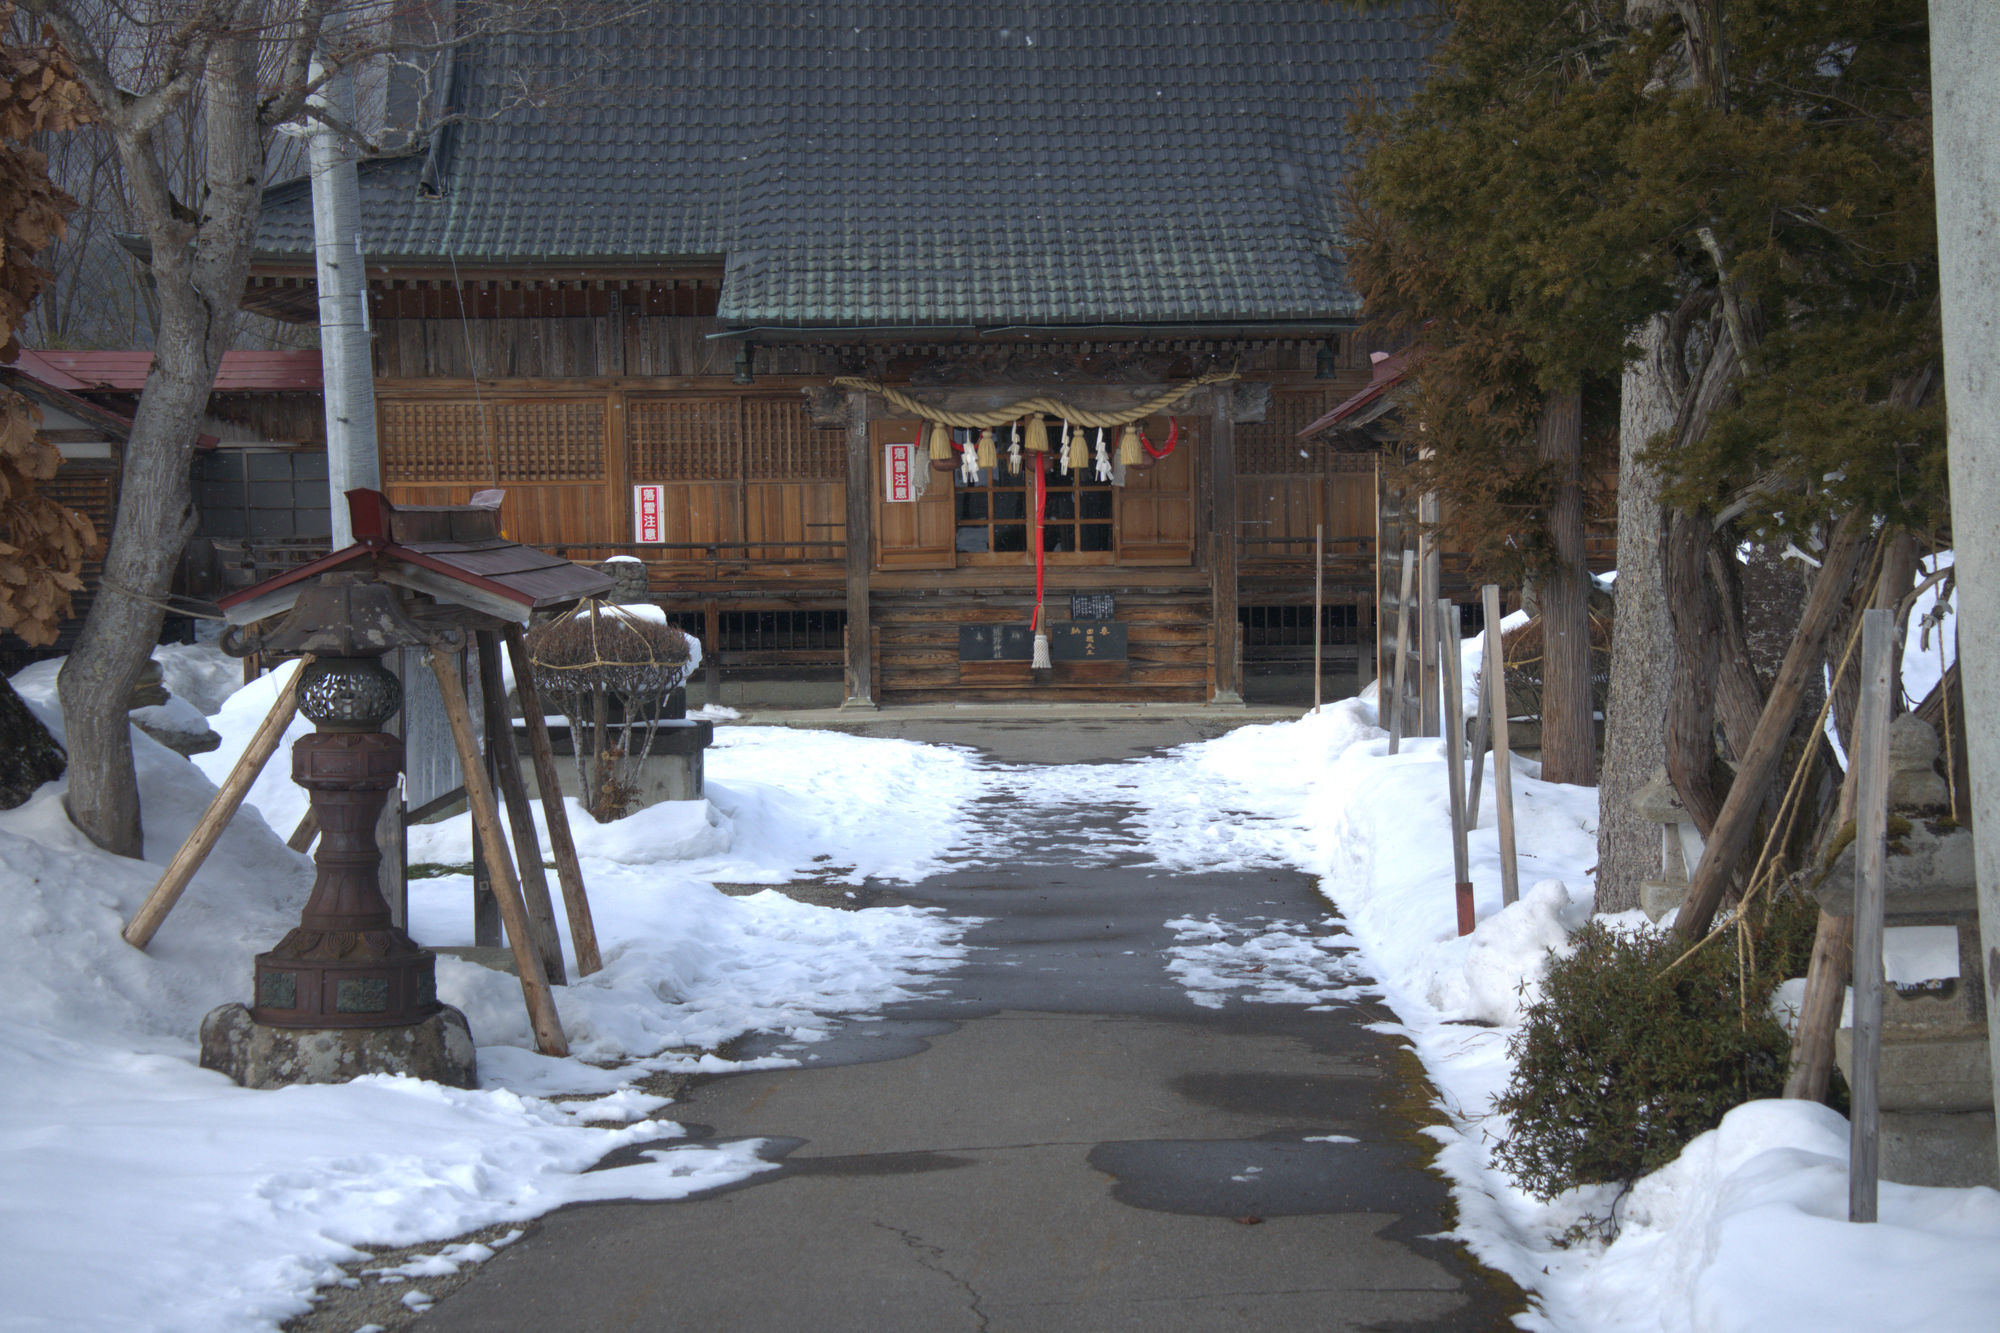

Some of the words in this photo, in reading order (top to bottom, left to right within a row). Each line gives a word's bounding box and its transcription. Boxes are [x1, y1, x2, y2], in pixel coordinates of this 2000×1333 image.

[894, 447, 907, 499] 落雪注意
[643, 488, 656, 541] 落雪注意
